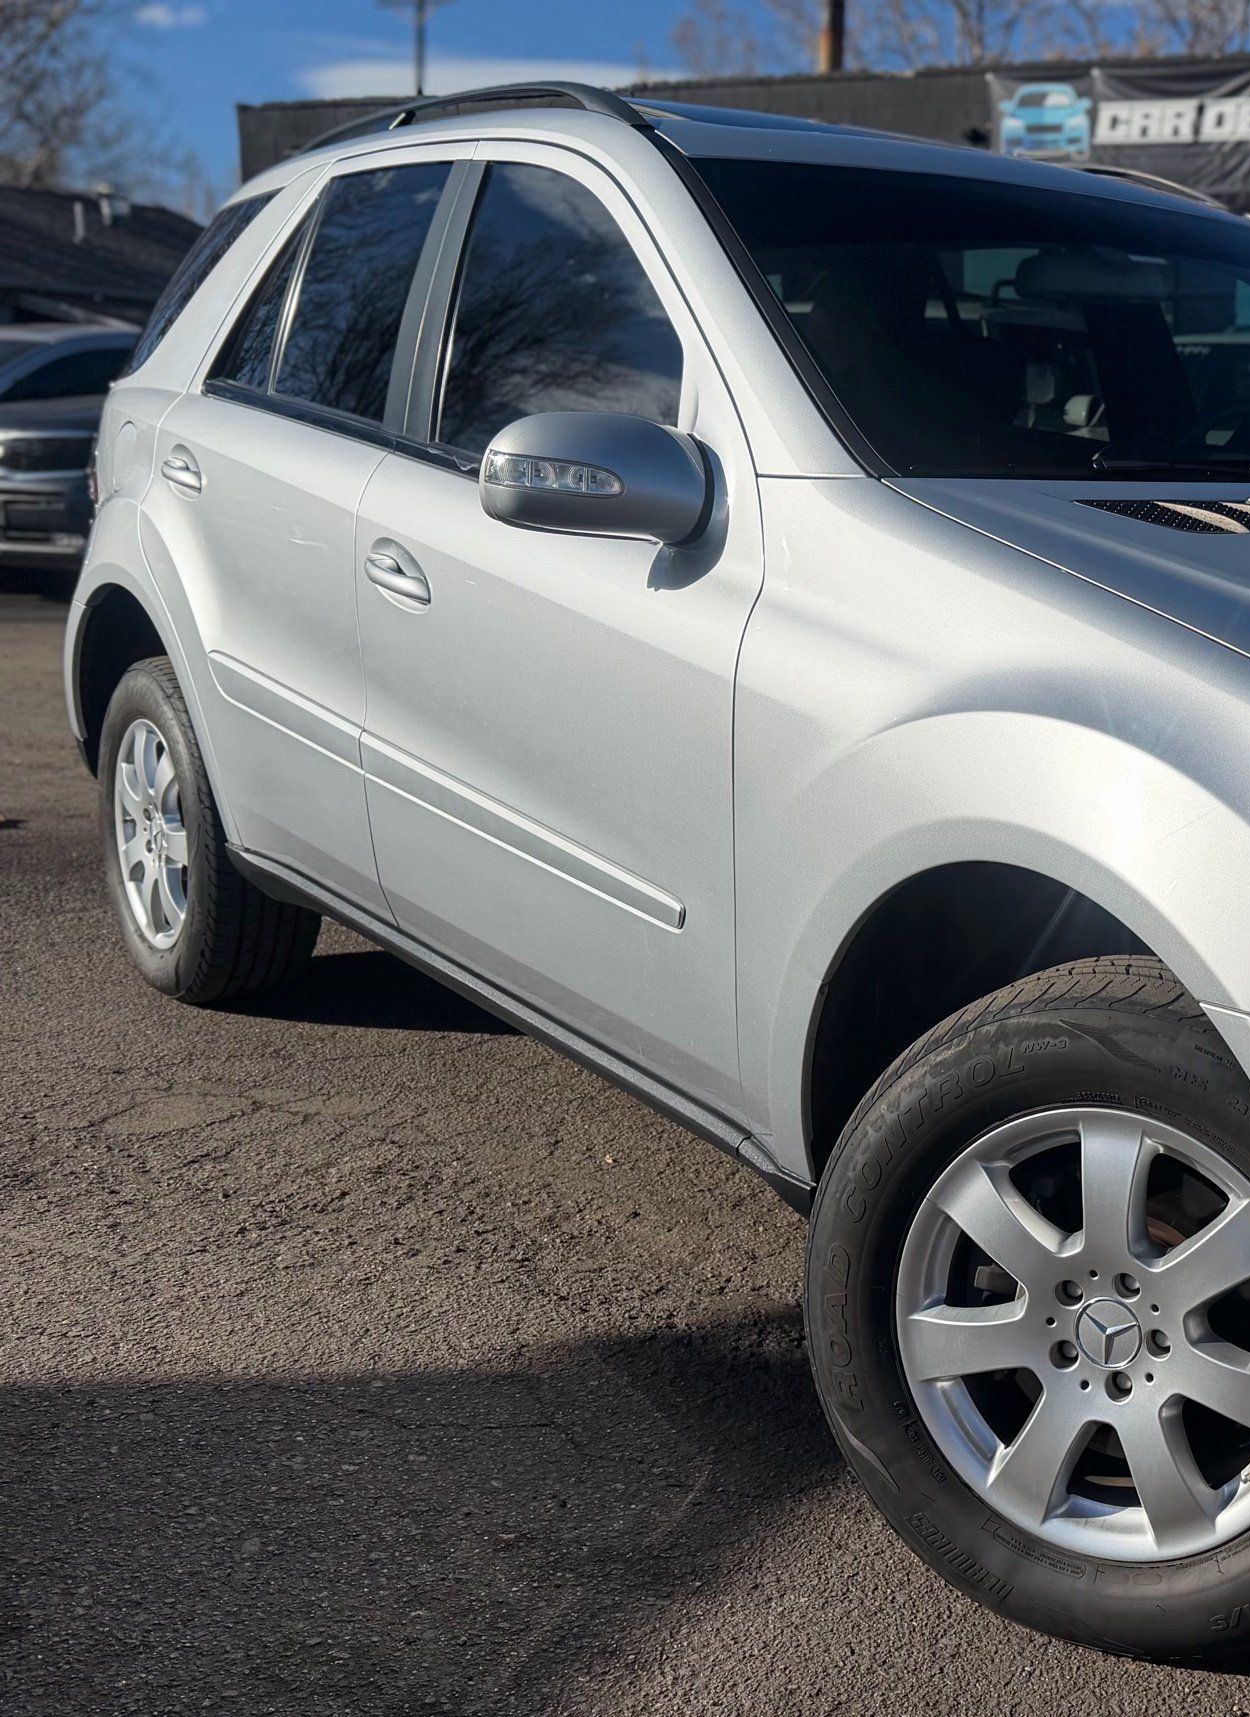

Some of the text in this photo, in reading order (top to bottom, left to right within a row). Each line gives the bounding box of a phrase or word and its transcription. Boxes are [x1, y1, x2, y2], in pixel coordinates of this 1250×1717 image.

[1094, 97, 1199, 145] CAR
[824, 1242, 865, 1412] ROAD
[846, 1046, 1025, 1224] CONTROL
